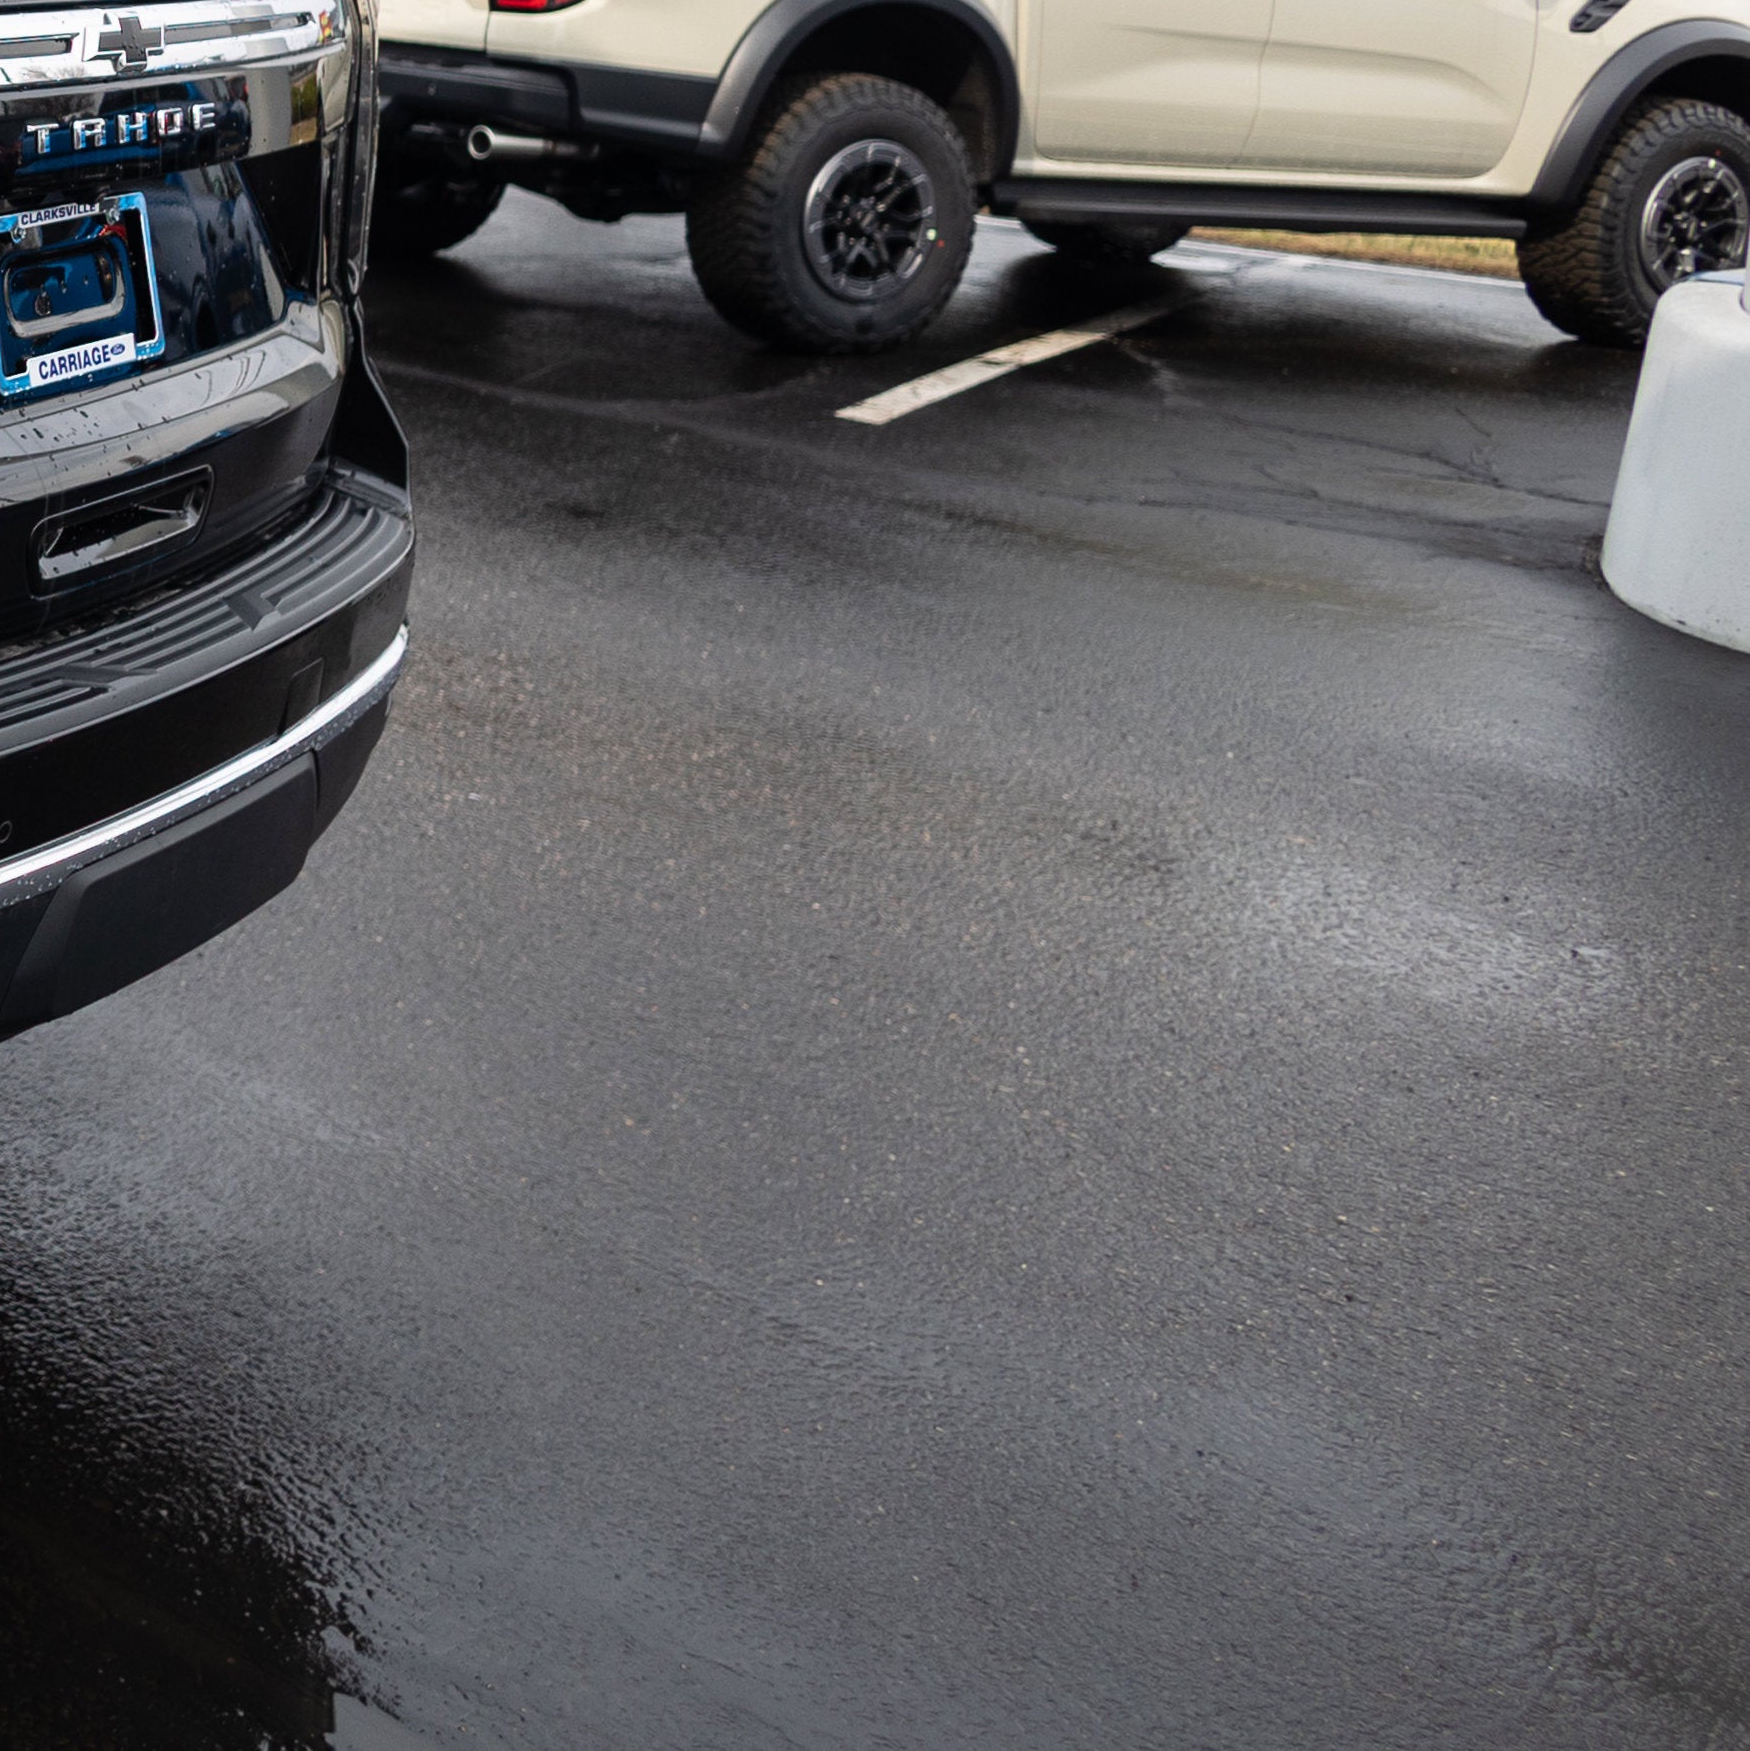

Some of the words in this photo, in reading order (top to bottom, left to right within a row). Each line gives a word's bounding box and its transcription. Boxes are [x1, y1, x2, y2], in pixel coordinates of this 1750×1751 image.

[25, 102, 217, 155] TAHOE
[20, 202, 97, 226] CLARKSVILLE
[38, 344, 111, 381] CARRIAGE
